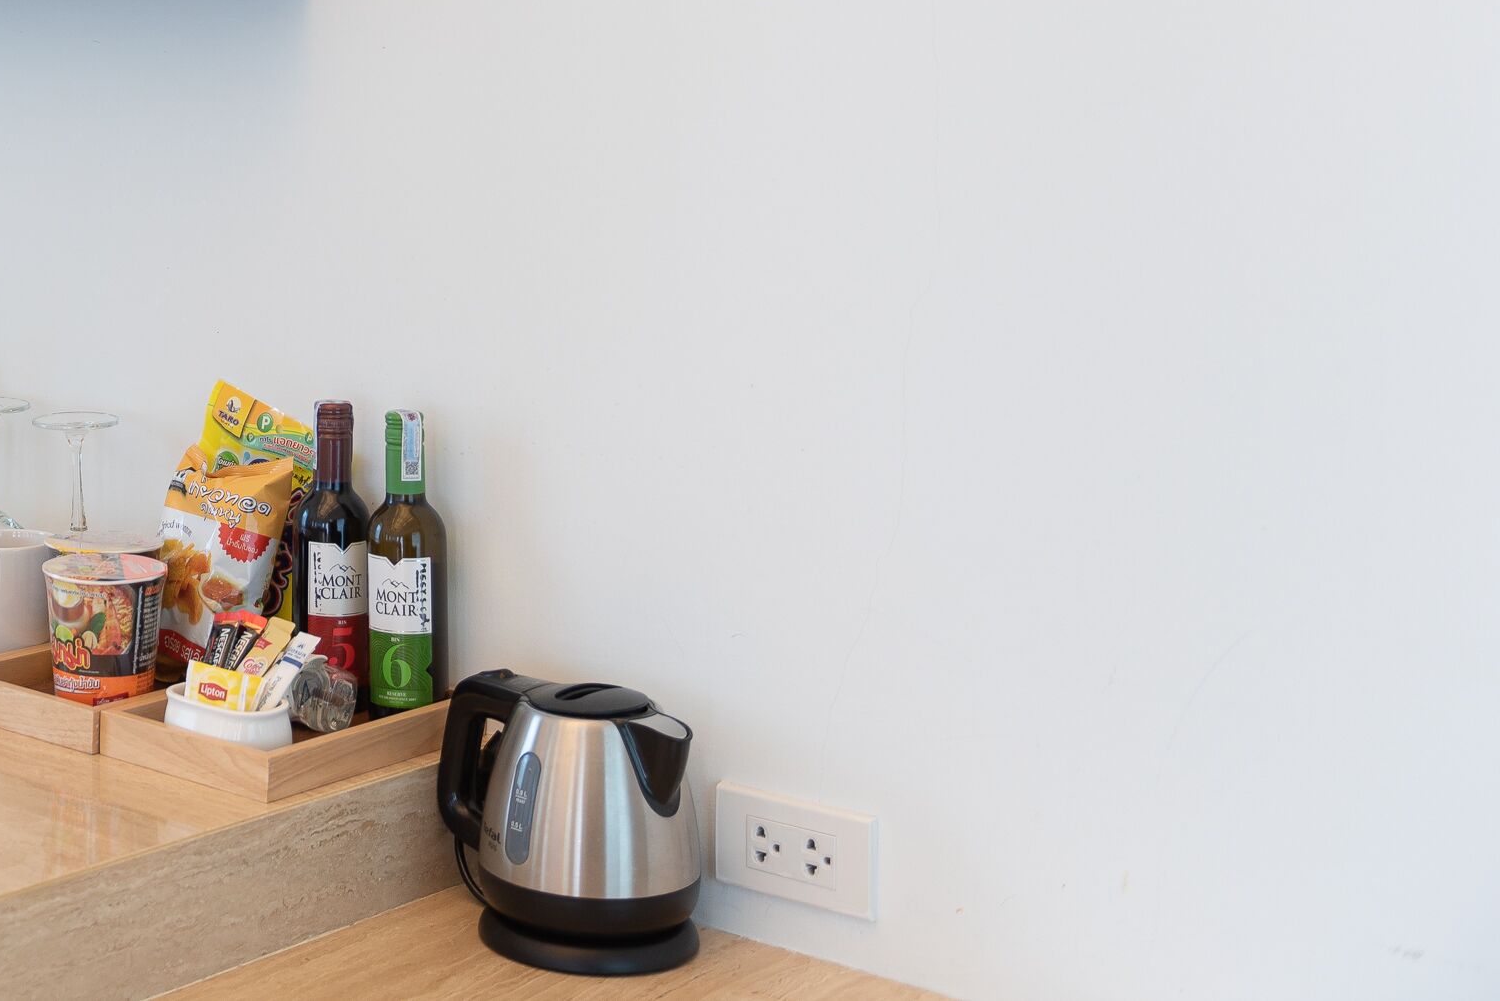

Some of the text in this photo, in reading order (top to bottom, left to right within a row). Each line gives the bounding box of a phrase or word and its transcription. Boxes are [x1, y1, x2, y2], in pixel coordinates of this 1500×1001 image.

[218, 410, 239, 426] TARO
[322, 573, 362, 587] MONT
[320, 586, 362, 600] CLAIR
[376, 588, 417, 603] MONT
[375, 601, 418, 616] CLAIR
[212, 628, 231, 667] NESCAF
[382, 643, 412, 689] 6
[200, 685, 226, 700] Lipton
